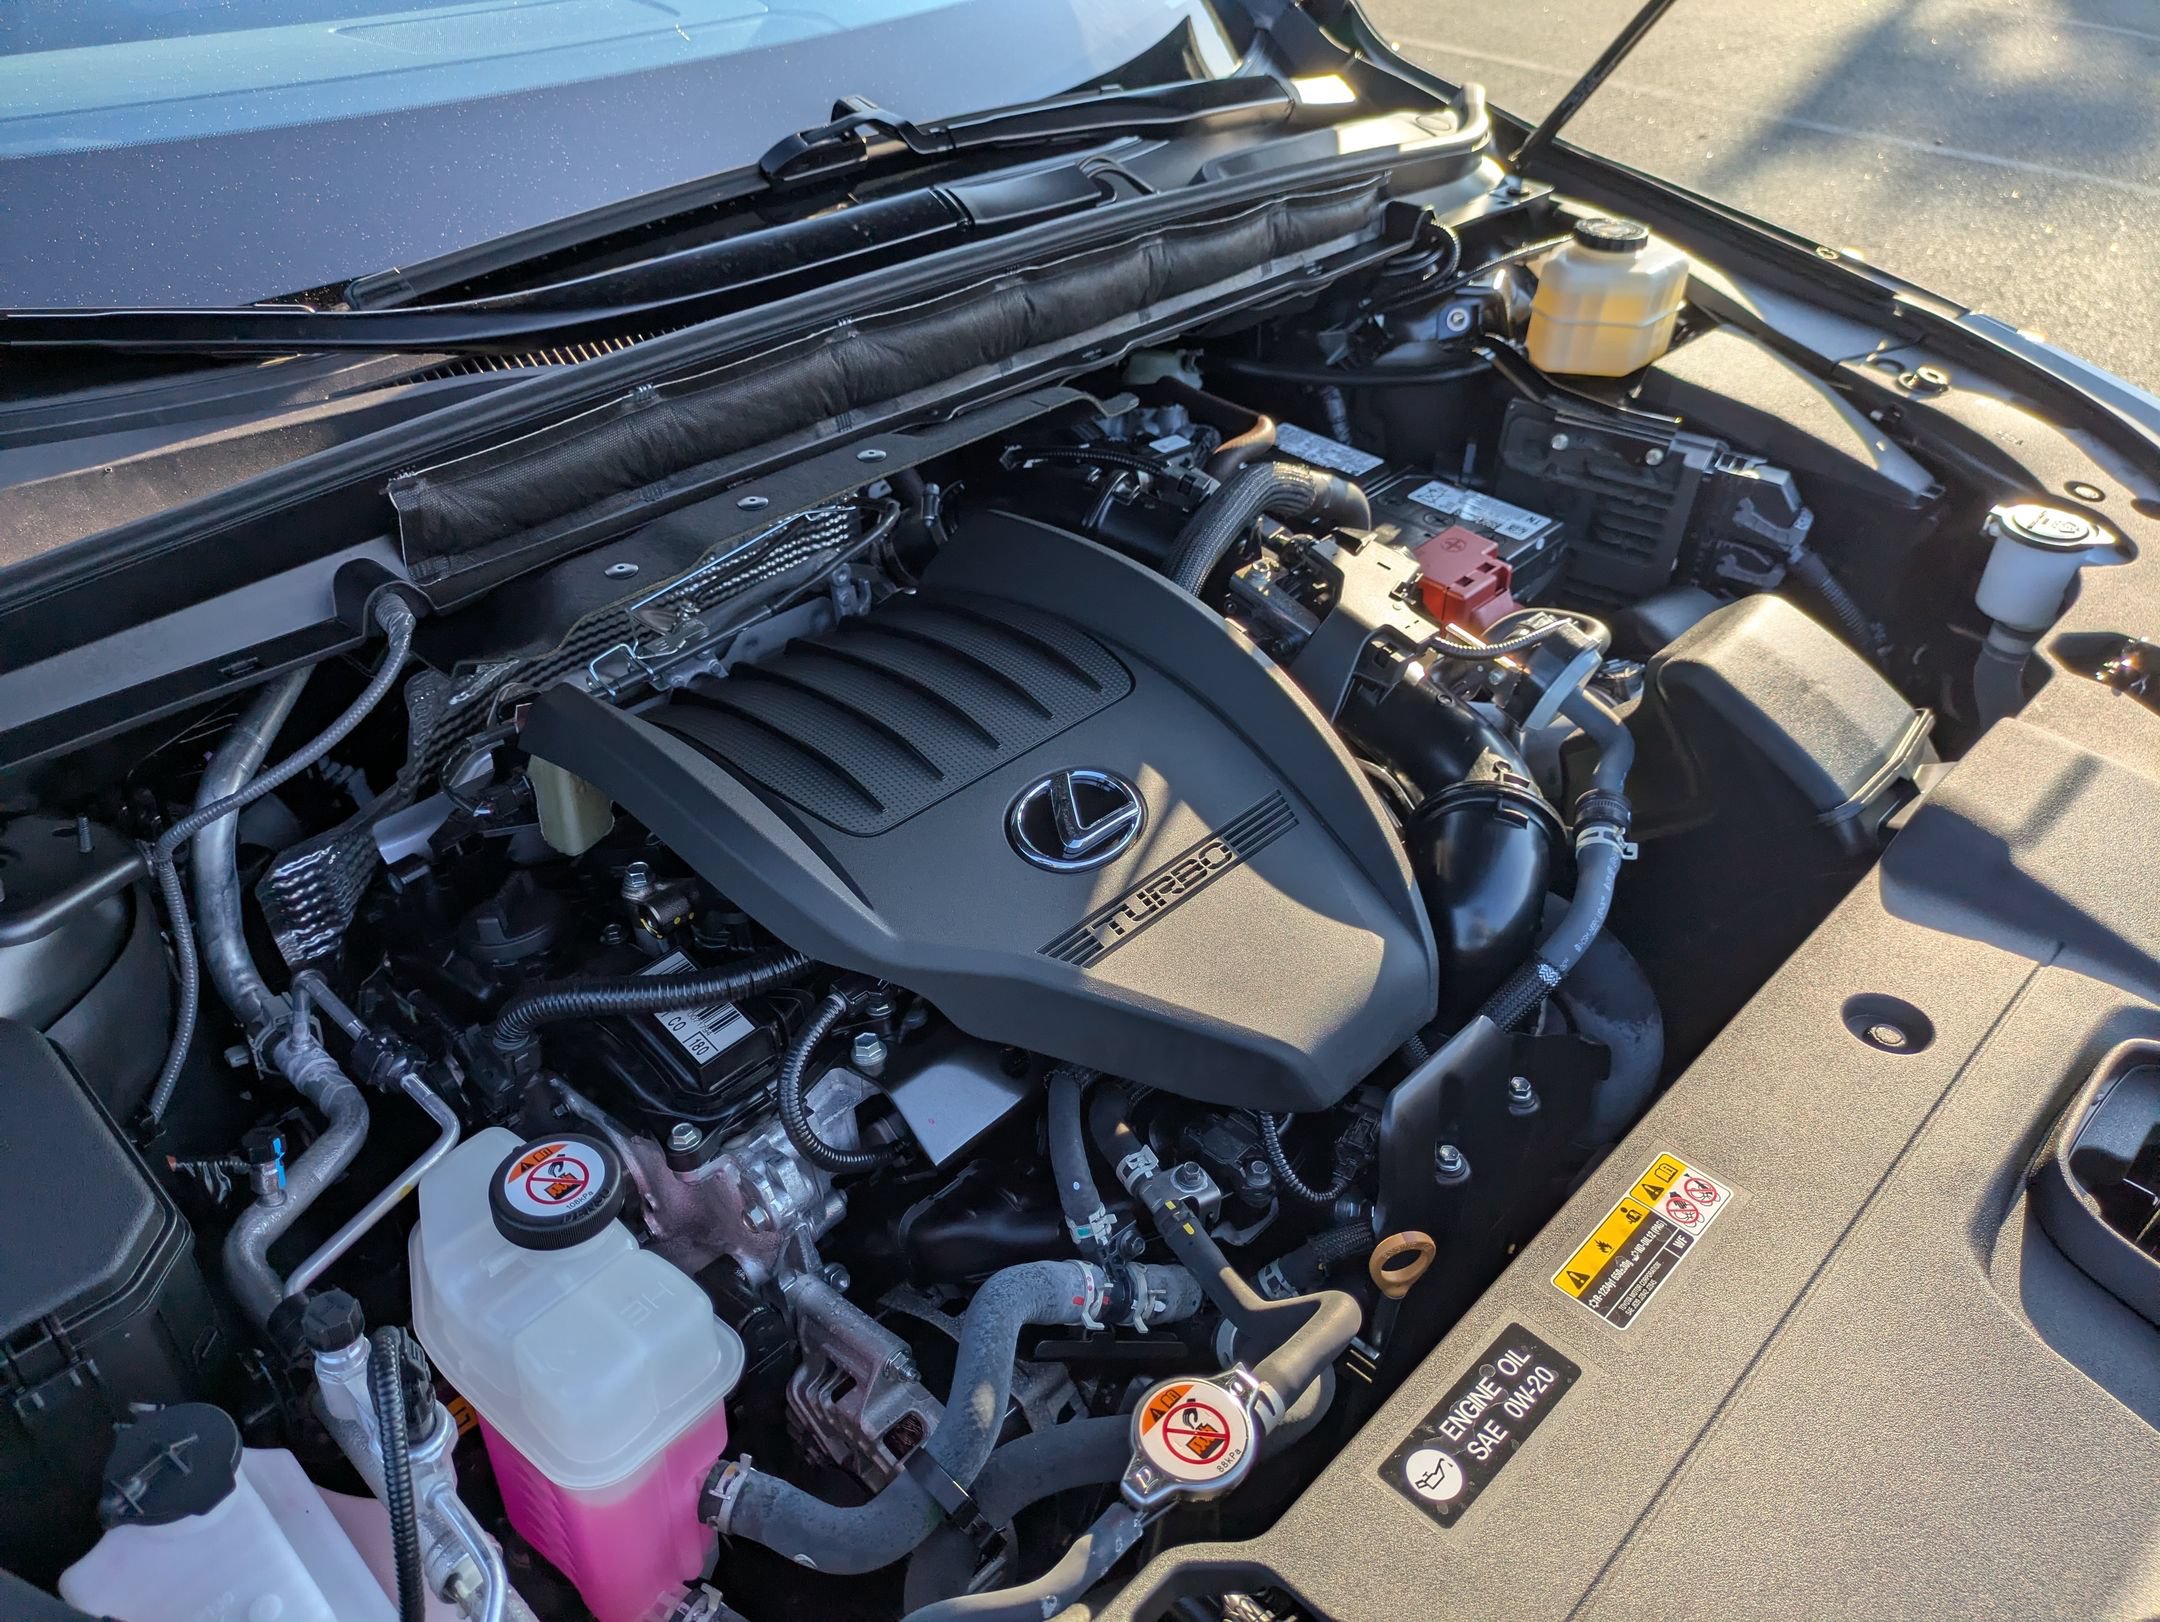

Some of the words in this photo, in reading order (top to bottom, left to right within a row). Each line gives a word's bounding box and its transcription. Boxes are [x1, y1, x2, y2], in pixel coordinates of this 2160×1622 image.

[1091, 841, 1234, 936] TURBO
[668, 1016, 687, 1031] CO
[689, 1039, 709, 1055] 180
[566, 1191, 594, 1210] 108kPa
[1672, 1234, 1688, 1249] WF
[1439, 1376, 1502, 1441] ENGINE
[1497, 1349, 1531, 1376] OIL
[1467, 1419, 1508, 1460] SAE
[1503, 1366, 1554, 1418] 0W-20
[1216, 1448, 1242, 1473] 88kPa
